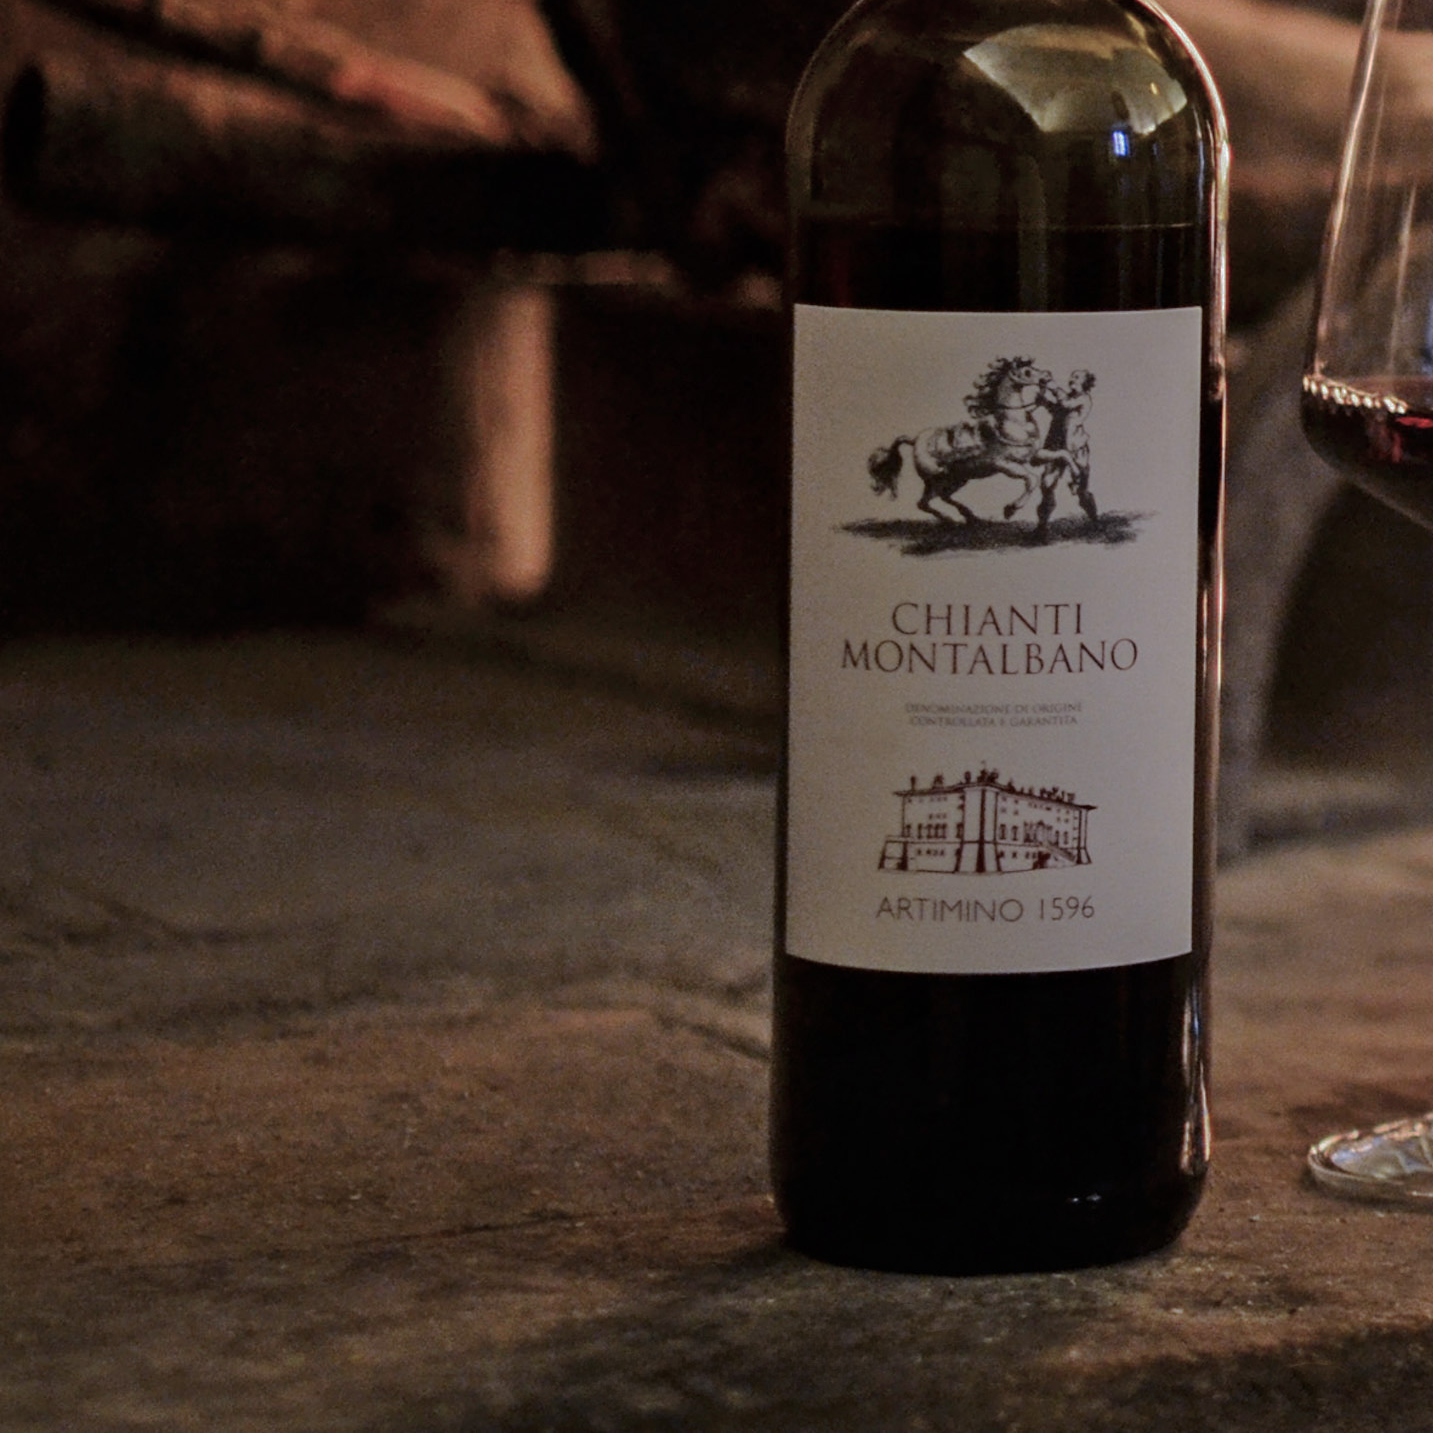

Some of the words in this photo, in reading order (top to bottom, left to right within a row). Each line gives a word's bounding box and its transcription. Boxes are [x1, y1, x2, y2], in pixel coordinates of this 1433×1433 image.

[891, 601, 1082, 637] CHIANTI
[840, 637, 1139, 676] MONTALBANO
[905, 702, 1010, 714] DENOMINAZIONE
[1015, 703, 1029, 714] DI
[1033, 701, 1082, 714] ORIGINE
[909, 715, 995, 727] CONTROLLATA
[1010, 715, 1078, 727] GARANTITA
[875, 896, 1024, 924] ARTIMINO
[1038, 895, 1096, 921] 1596
